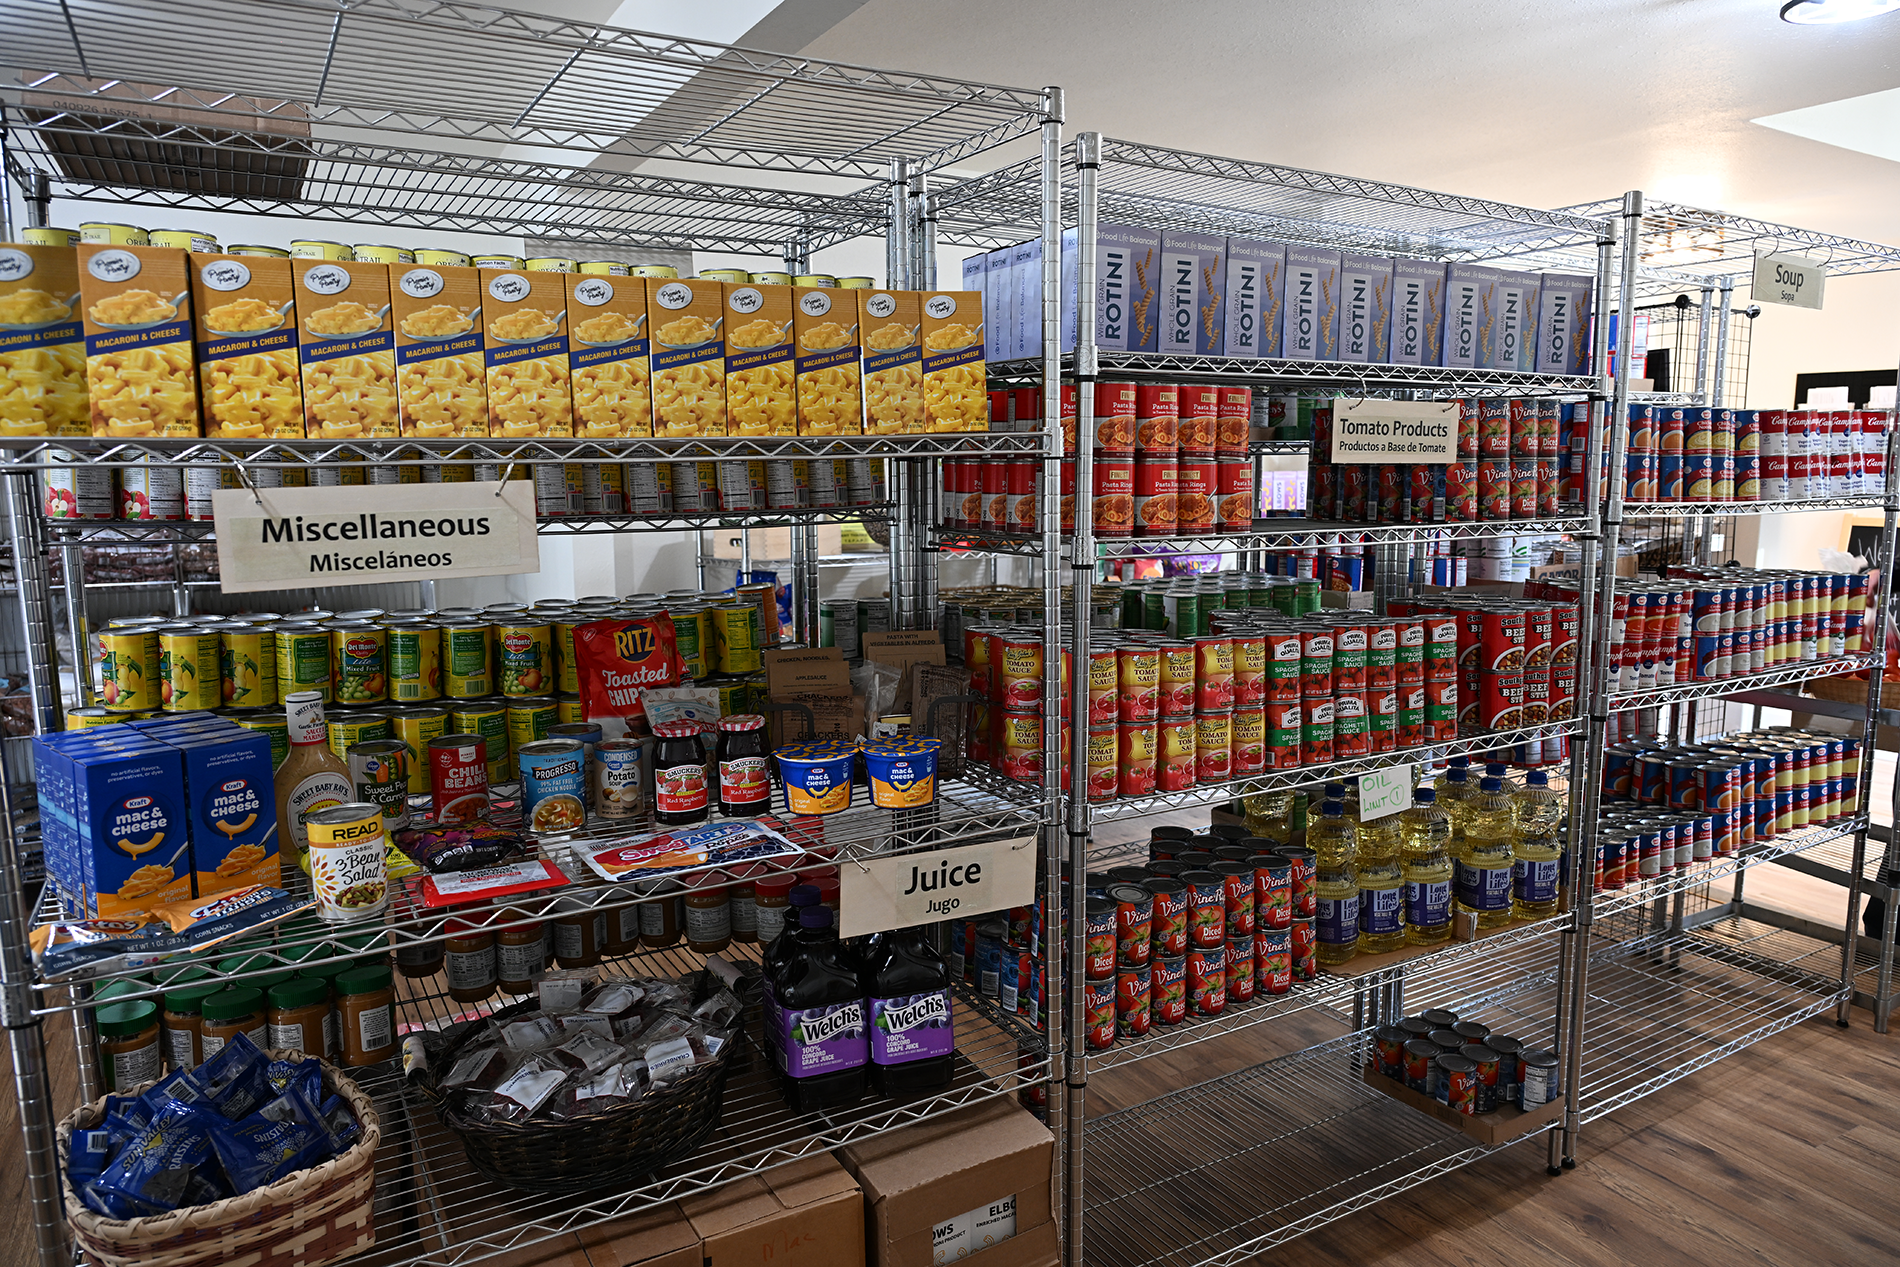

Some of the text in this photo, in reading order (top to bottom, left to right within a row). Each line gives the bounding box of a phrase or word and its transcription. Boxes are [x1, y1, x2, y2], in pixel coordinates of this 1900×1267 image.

[53, 100, 99, 113] 040926
[1101, 233, 1157, 246] Food Life Balanced
[1171, 238, 1224, 253] Food Life Balanced
[1775, 264, 1804, 288] Soup
[1106, 252, 1123, 340] ROTINI
[1176, 260, 1192, 344] ROTINI
[1781, 290, 1795, 302] Sopa
[1240, 266, 1255, 347] ROTINI
[1299, 273, 1312, 350] ROTINI
[1350, 279, 1366, 354] ROTINI
[1404, 283, 1419, 356] ROTINI
[96, 328, 181, 348] MACARONI & CHEESE
[1551, 296, 1566, 364] ROTINI
[208, 335, 288, 354] MACARONI & CHEESE
[311, 344, 349, 356] MACARONI
[359, 337, 385, 348] CHEESE
[579, 350, 611, 362] MACARONI
[619, 345, 641, 354] CHEESE
[929, 356, 955, 367] MACARONI
[961, 350, 979, 359] CHEESE
[1340, 418, 1448, 438] Tomato Products
[1339, 441, 1378, 452] Productos
[1388, 443, 1404, 452] Base
[1407, 443, 1417, 452] de
[1419, 443, 1446, 453] Tomate
[1492, 438, 1507, 446] Diced
[261, 513, 490, 543] Miscellaneous
[309, 549, 453, 573] Misceláneos
[613, 627, 656, 658] RITZ
[602, 662, 669, 687] Toasted
[1524, 683, 1548, 691] BEEF
[604, 751, 638, 762] CONDENSED
[108, 773, 144, 783] preservatives,
[119, 767, 140, 775] artificial
[449, 763, 485, 778] CHILI
[535, 762, 576, 779] PROGRESSO
[608, 771, 635, 781] Potato
[226, 782, 242, 790] Kraft
[445, 773, 487, 789] BEANS
[538, 784, 577, 794] CHICKEN NOODLE
[1362, 775, 1392, 791] OIL
[293, 787, 315, 806] SWEET
[315, 783, 333, 792] BABY
[365, 785, 394, 794] Sweet
[129, 798, 147, 807] Kraft
[214, 790, 256, 806] mac &
[370, 795, 377, 803] &
[681, 795, 704, 803] Raspberry
[116, 807, 162, 824] mac &
[333, 822, 378, 840] READ
[336, 835, 378, 847] READY-TO-EAT
[345, 845, 373, 855] CLASSIC
[251, 863, 278, 876] original
[335, 852, 380, 871] 3 Bean
[258, 870, 279, 881] flavor
[341, 863, 380, 885] Salad
[904, 860, 981, 895] Juice
[1378, 891, 1396, 901] Long
[926, 898, 960, 914] Jugo
[1276, 908, 1291, 918] Diced
[195, 923, 234, 939] CORN SNACKS
[1203, 927, 1221, 936] Diced
[1094, 956, 1113, 967] Diced
[1274, 973, 1289, 983] Diced
[887, 999, 944, 1030] Welch's
[804, 1008, 860, 1041] Welch's
[887, 1034, 905, 1042] 100%
[887, 1039, 910, 1047] CONCORD
[122, 1116, 170, 1172] SUN VALLEY
[169, 1134, 201, 1170] RAISINS
[945, 1230, 966, 1243] PRODUCT
